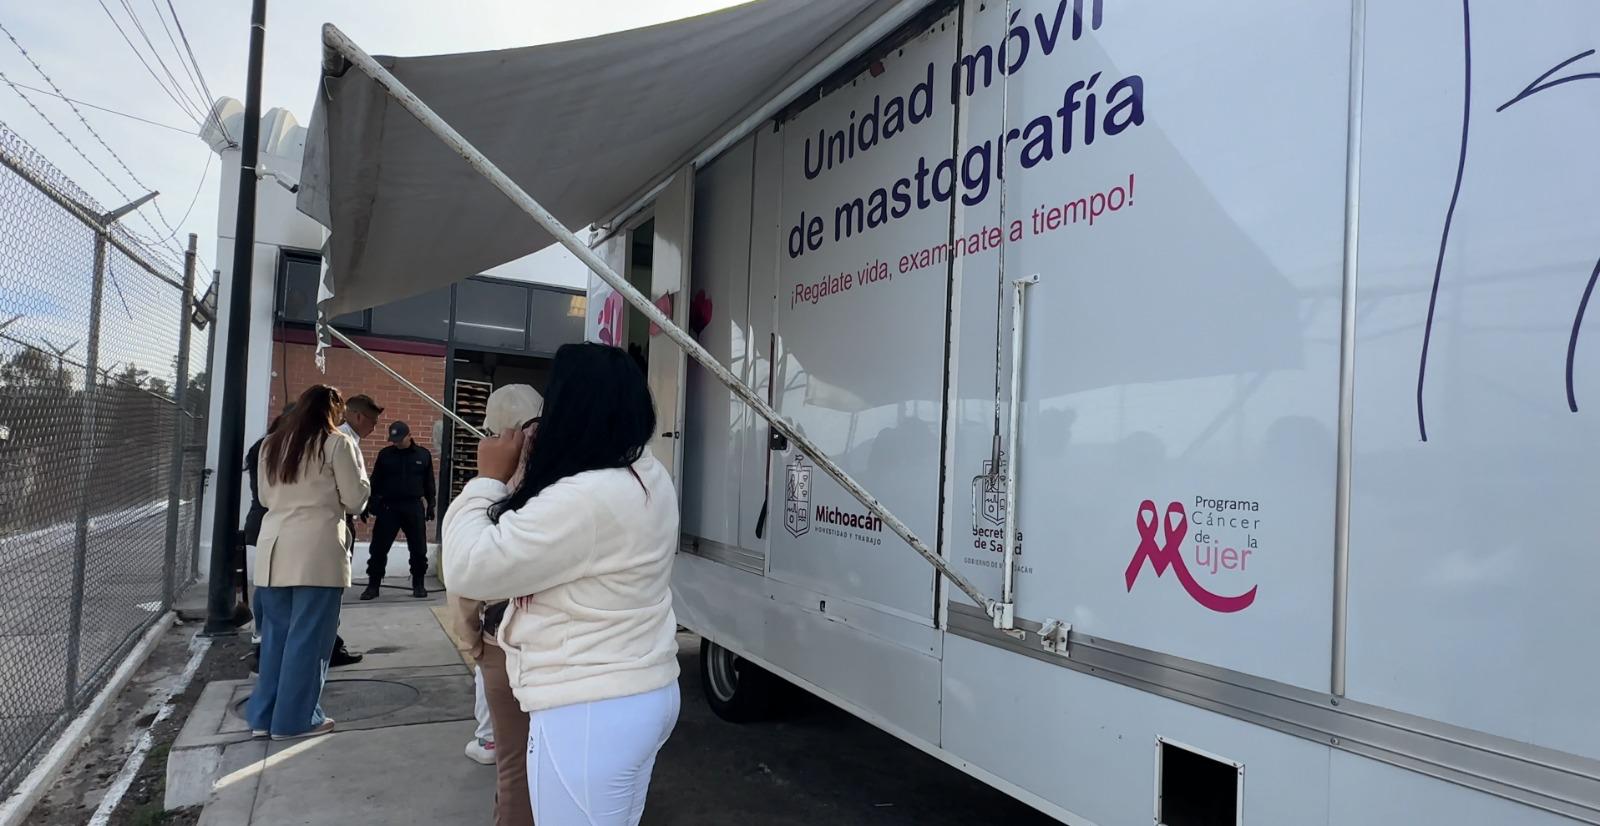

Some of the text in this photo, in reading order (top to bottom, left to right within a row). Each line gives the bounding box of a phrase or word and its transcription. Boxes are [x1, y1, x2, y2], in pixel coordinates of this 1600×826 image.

[804, 62, 934, 180] Unidad
[788, 71, 1144, 259] de mastografía
[791, 174, 1134, 310] ¡Regálate vida, examnate a tiempo!
[1195, 496, 1259, 511] Programa
[815, 505, 882, 532] Michoacán
[1192, 511, 1260, 529] Cáncer
[855, 534, 881, 545] TRABAJO
[974, 538, 1022, 555] de Sad
[1195, 530, 1257, 548] de la
